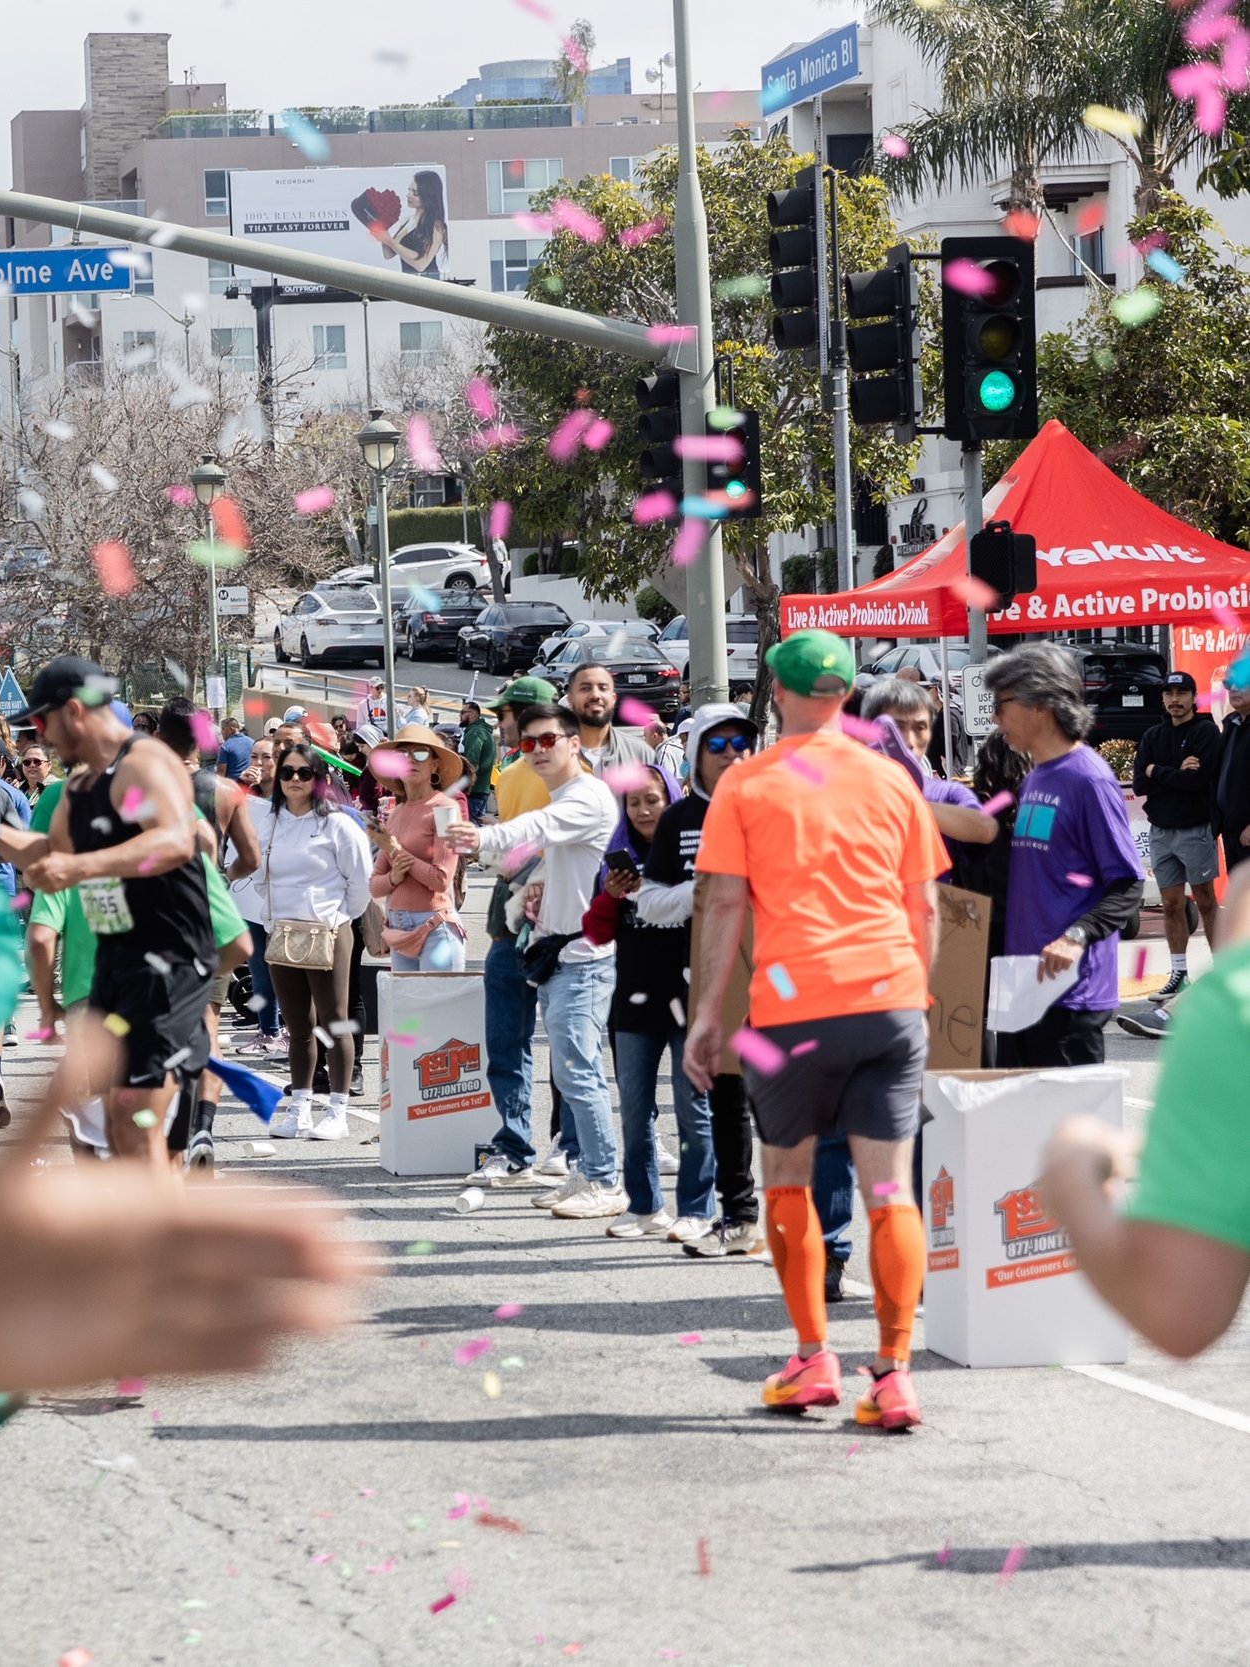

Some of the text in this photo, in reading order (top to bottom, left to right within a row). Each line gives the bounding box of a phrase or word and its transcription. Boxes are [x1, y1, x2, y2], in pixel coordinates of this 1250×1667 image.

[767, 36, 853, 95] Santa Monica Bl
[245, 209, 348, 221] 100% REAL ROSES
[248, 222, 345, 232] THAT LAST FOREVER
[67, 258, 114, 282] Ave
[899, 524, 936, 543] VILLAS
[1036, 541, 1206, 567] Yakult
[1026, 595, 1048, 620] &
[1052, 590, 1136, 618] Active
[1141, 583, 1250, 612] Probioti
[788, 601, 929, 628] Live & Active Probiotic Drink
[1181, 627, 1204, 651] Live
[1205, 629, 1215, 652] &
[423, 1080, 480, 1098] 877-JONTOGO
[413, 1095, 486, 1116] "Our Customers Go 1st!"
[1008, 1233, 1070, 1257] 877-JONT
[993, 1269, 1014, 1281] "Our
[1015, 1262, 1061, 1278] Customers
